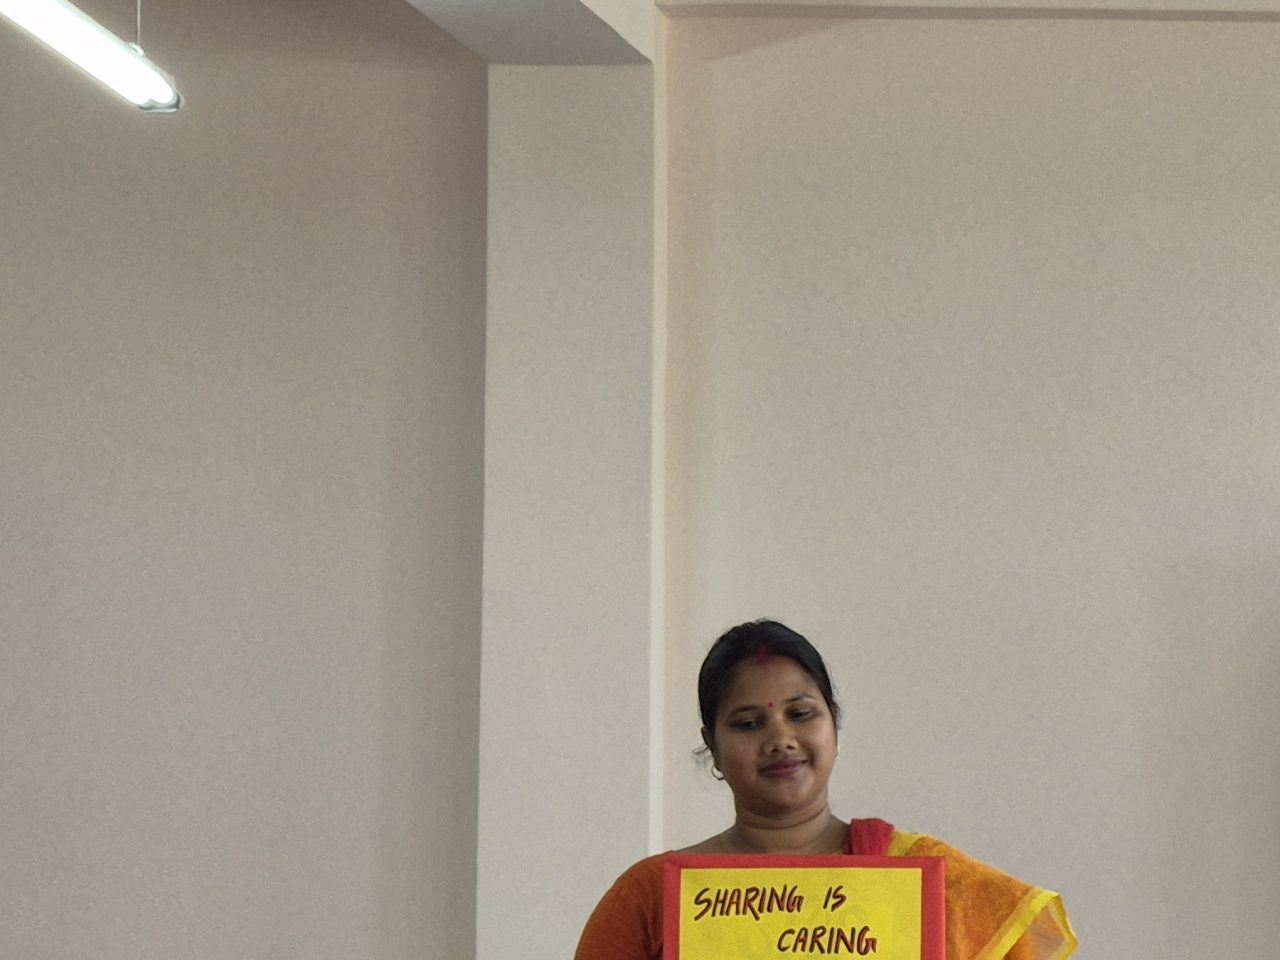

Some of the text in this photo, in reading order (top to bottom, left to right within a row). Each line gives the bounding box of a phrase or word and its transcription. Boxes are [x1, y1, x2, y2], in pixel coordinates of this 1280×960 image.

[693, 884, 847, 921] SHARING IS
[777, 925, 877, 955] CARING
